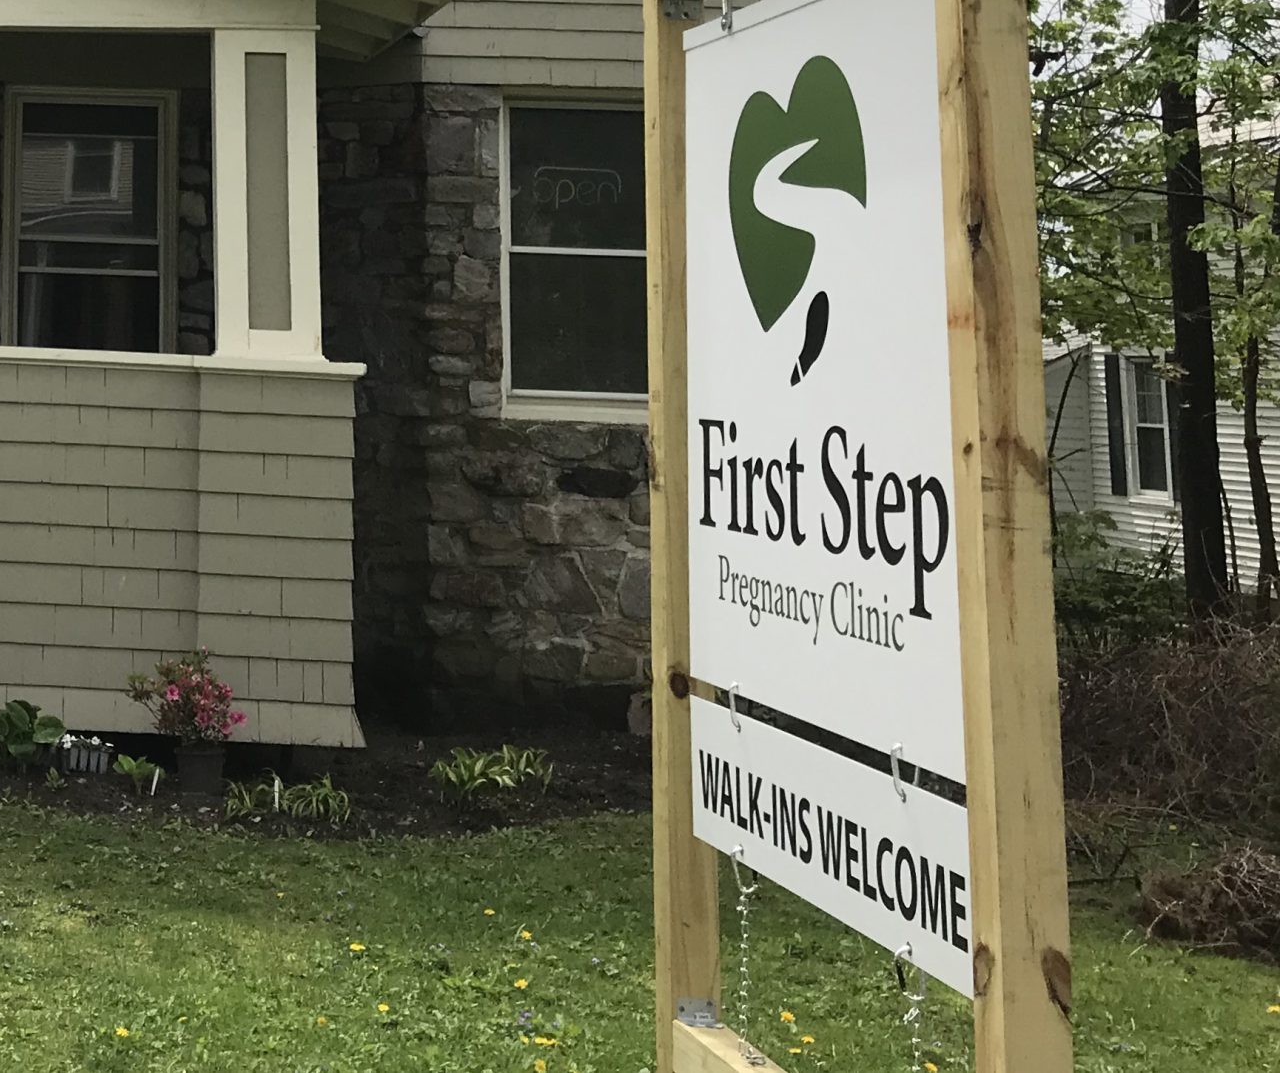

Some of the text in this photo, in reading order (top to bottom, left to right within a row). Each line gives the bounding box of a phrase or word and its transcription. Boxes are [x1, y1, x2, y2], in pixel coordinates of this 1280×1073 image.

[698, 418, 950, 620] First Step
[718, 554, 906, 652] Pregnancy Clinic
[699, 749, 970, 954] WALK-INS WELCOME
